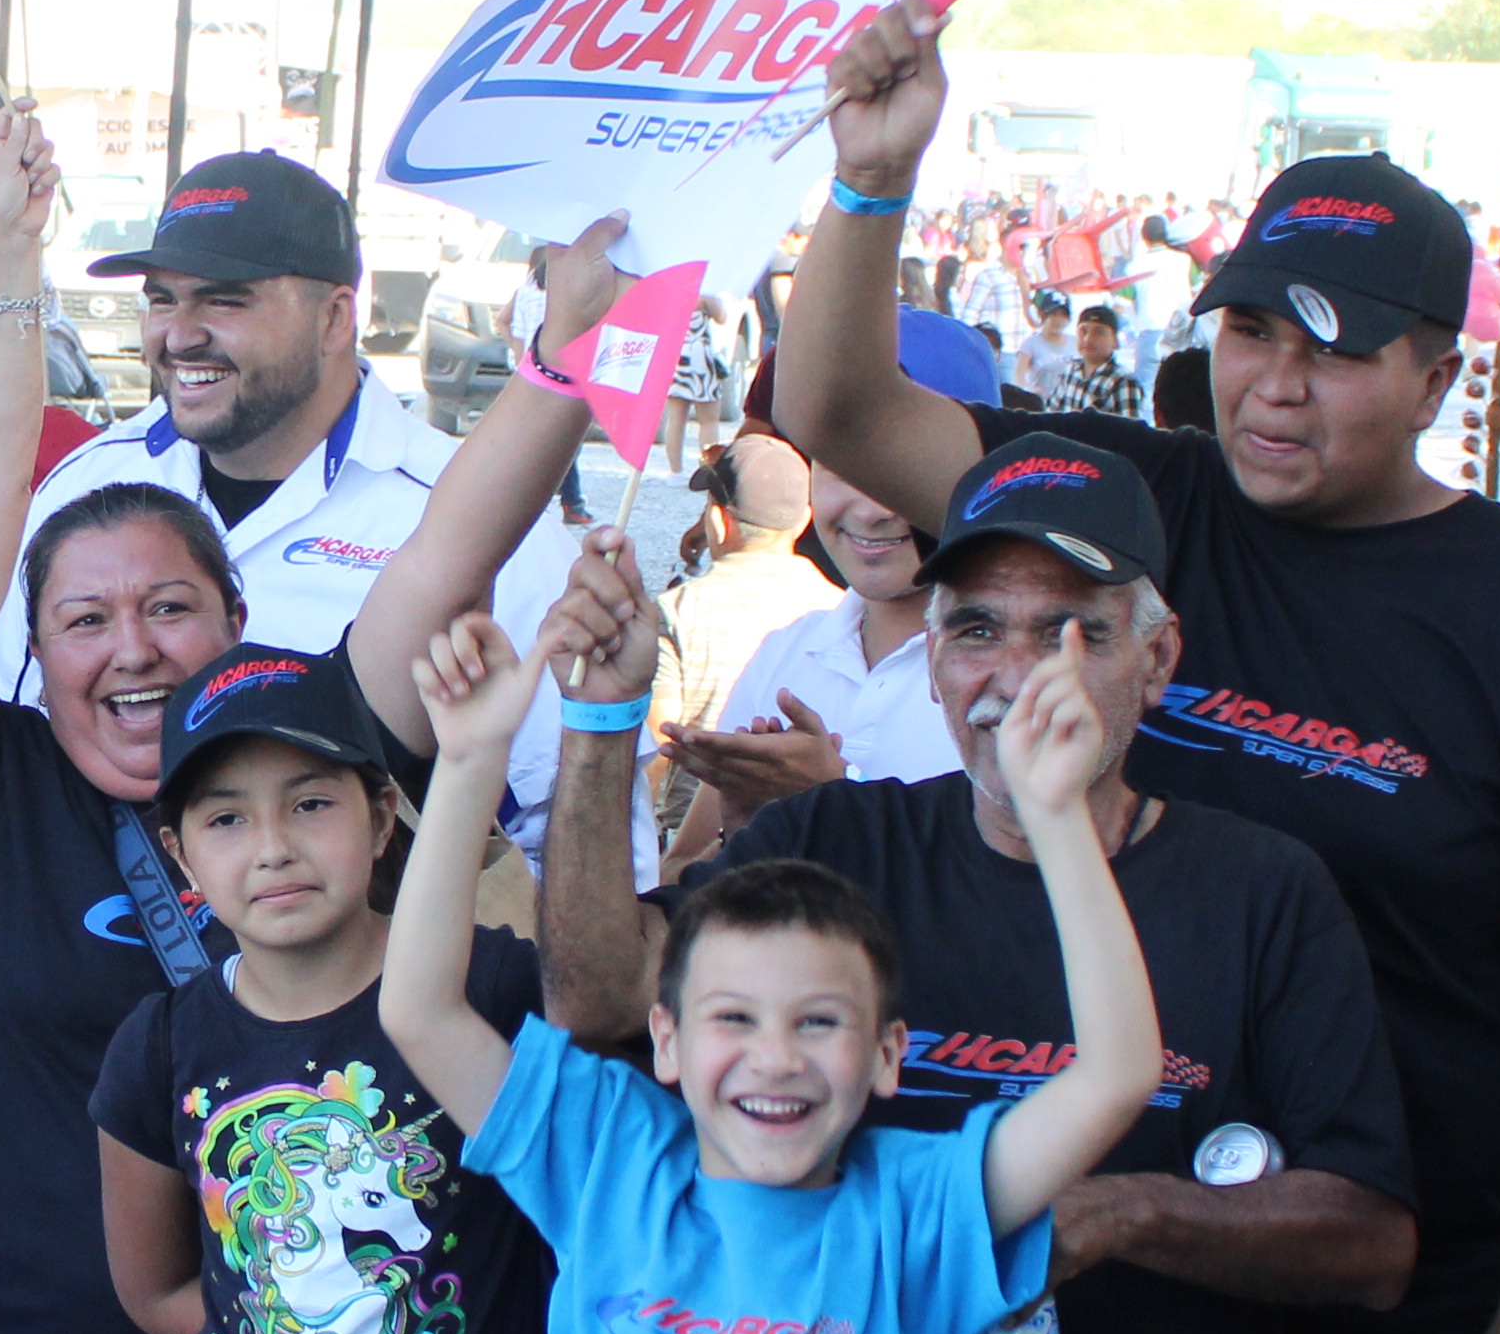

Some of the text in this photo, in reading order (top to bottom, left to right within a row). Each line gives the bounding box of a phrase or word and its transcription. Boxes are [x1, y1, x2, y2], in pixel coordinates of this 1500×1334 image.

[585, 112, 711, 153] SUPER
[1191, 688, 1388, 768] HCARGA
[1243, 739, 1399, 795] SUPER EXPRESS
